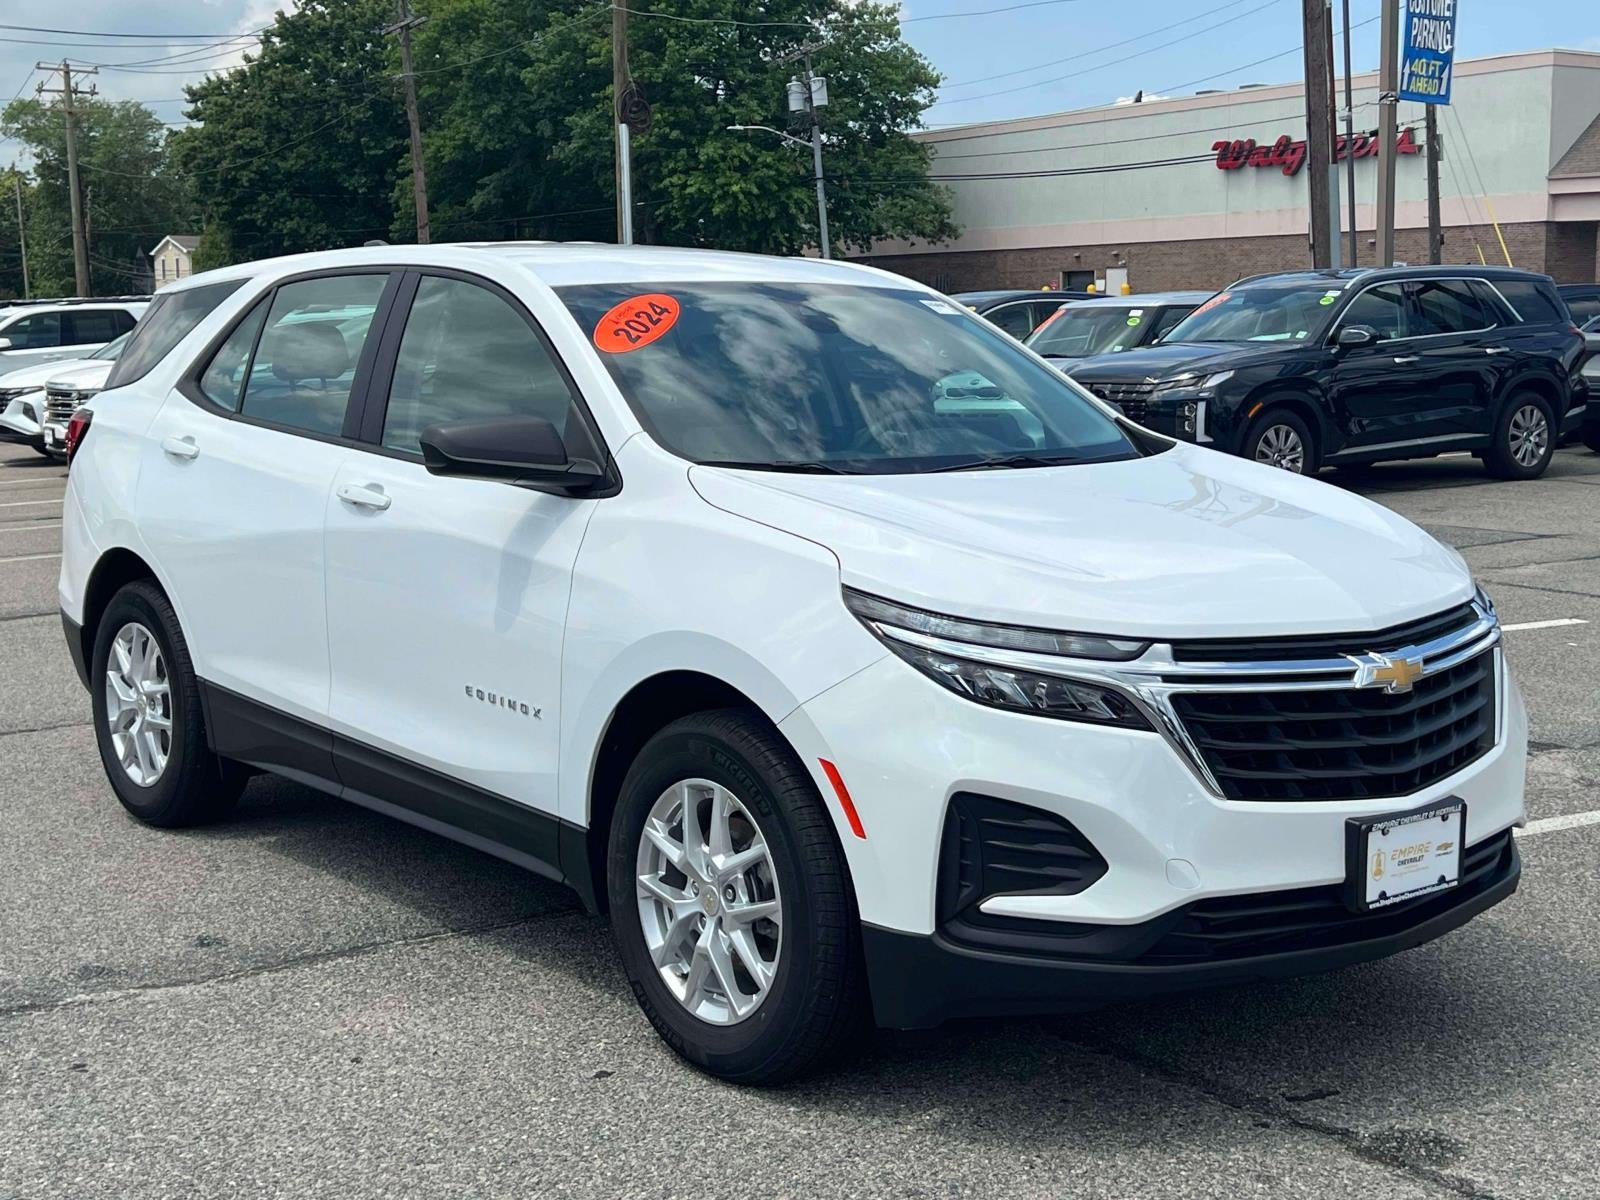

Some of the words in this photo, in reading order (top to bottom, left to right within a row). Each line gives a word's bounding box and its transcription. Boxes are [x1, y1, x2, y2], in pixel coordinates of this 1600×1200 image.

[1411, 17, 1453, 53] PARKING
[1411, 58, 1427, 75] 40
[1429, 61, 1443, 77] FT
[1409, 76, 1439, 95] AHEAD
[613, 301, 672, 344] 2024
[465, 685, 542, 720] EQUINOX
[1391, 842, 1431, 860] EMPIRE
[1397, 854, 1424, 866] CHEVROLET
